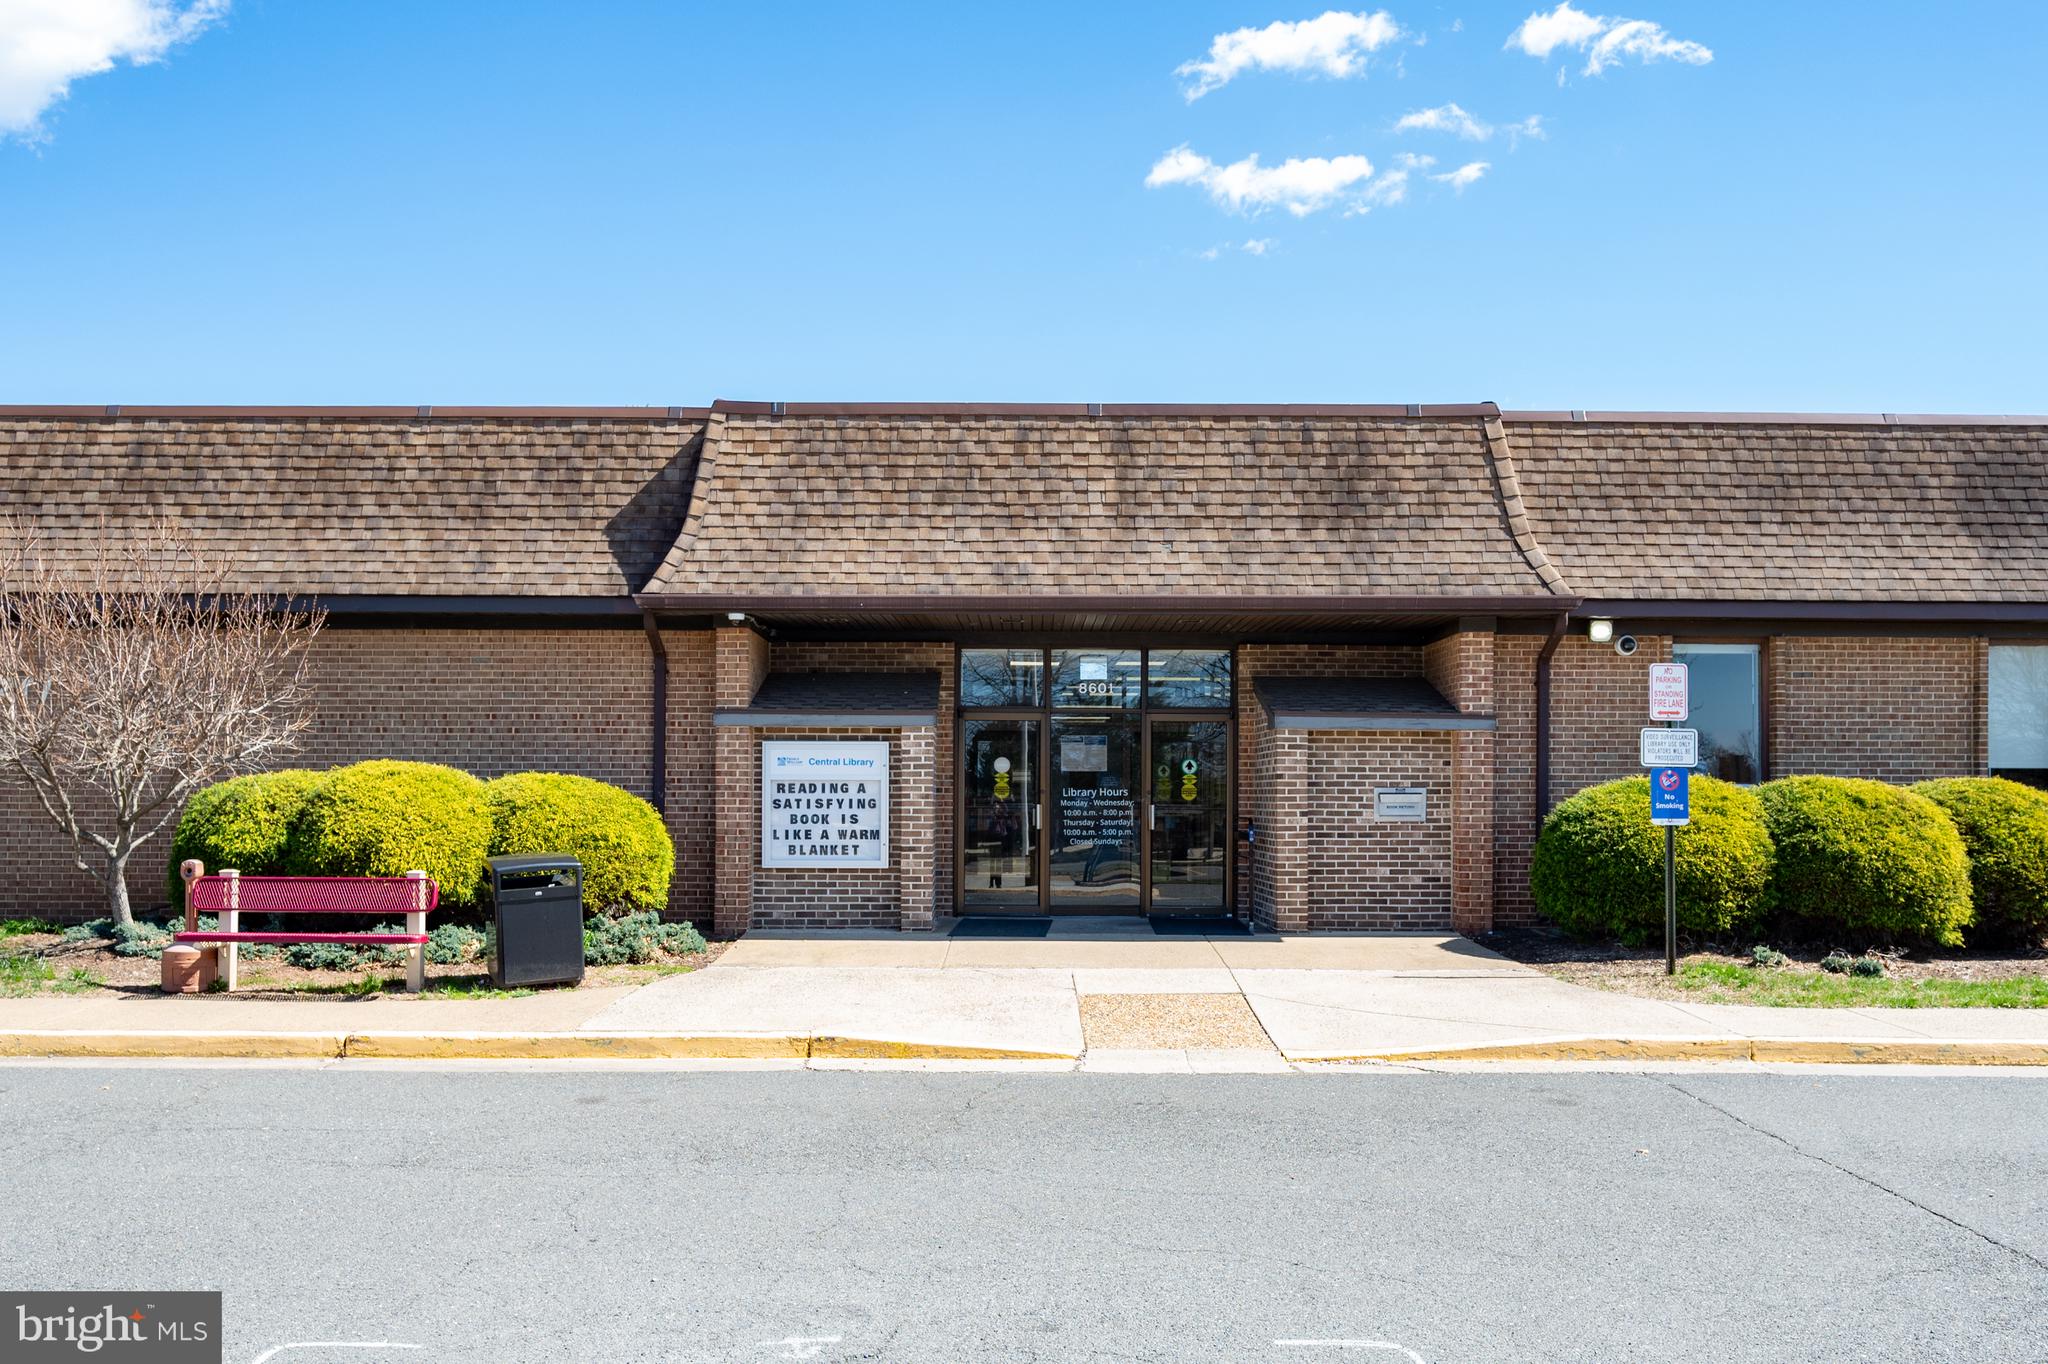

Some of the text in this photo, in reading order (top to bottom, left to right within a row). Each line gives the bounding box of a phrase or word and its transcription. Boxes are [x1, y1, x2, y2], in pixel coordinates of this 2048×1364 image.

[1664, 667, 1673, 675] NO
[1656, 676, 1682, 684] PARKING
[1079, 682, 1114, 694] 8601
[1654, 690, 1684, 698] STANDING
[1654, 699, 1684, 708] FIRE LANE
[808, 758, 841, 766] Central
[842, 758, 874, 768] Library
[776, 783, 866, 794] READING A
[1062, 788, 1129, 799] Library Hours
[772, 798, 877, 809] SATISFYING
[790, 814, 859, 824] BOOK IS
[1063, 819, 1095, 827] Thursday
[772, 829, 880, 840] LIKE A WARM
[1094, 838, 1123, 846] Sundays
[788, 845, 860, 856] BLANKET
